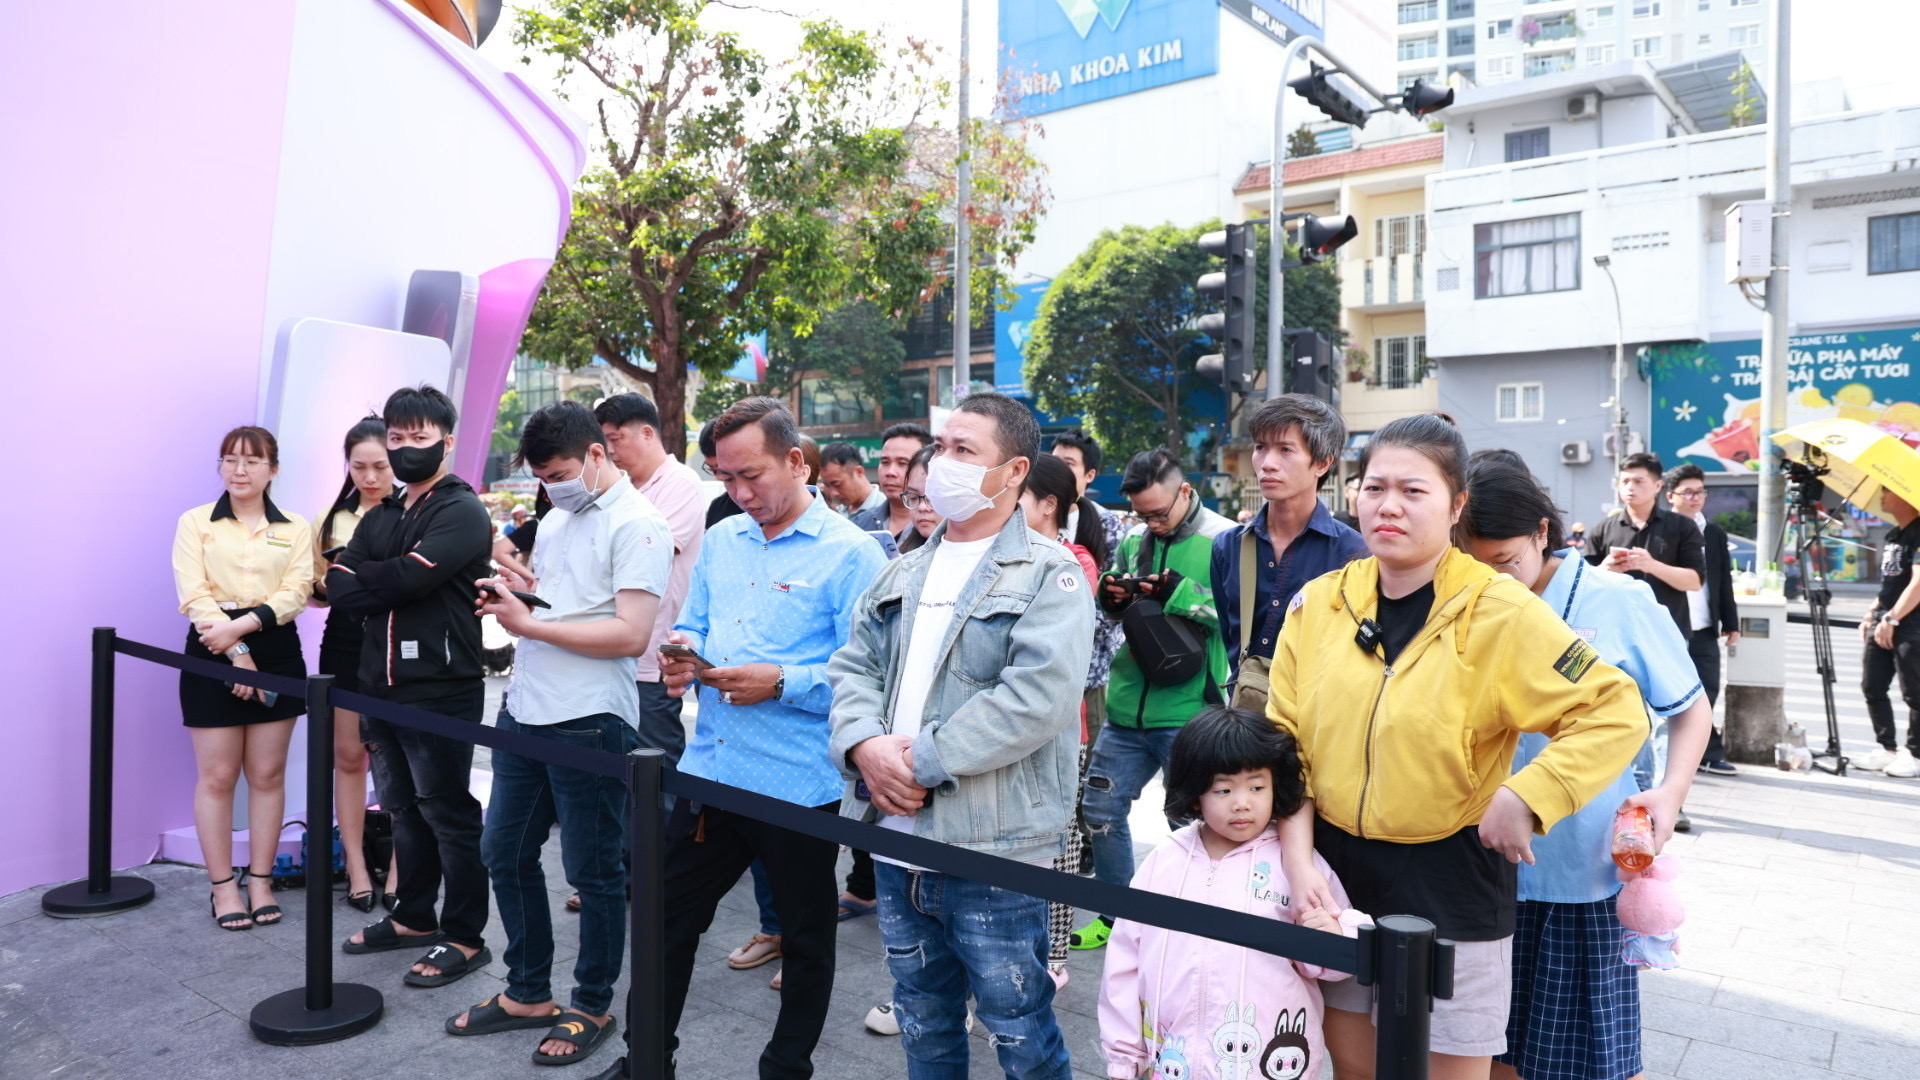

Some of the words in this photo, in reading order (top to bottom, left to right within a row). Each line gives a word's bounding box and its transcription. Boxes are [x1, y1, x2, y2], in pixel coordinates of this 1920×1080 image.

[1251, 4, 1287, 41] IMPLANT
[1070, 53, 1130, 85] KHOA
[1138, 39, 1183, 69] KIM
[1825, 334, 1847, 345] TEA
[1735, 355, 1762, 369] TR
[1787, 349, 1814, 365] ỮA
[1817, 349, 1857, 364] PHA
[1787, 365, 1814, 383] RÁI
[1061, 577, 1075, 588] 10
[1254, 888, 1291, 909] LABU
[428, 945, 448, 960] T
